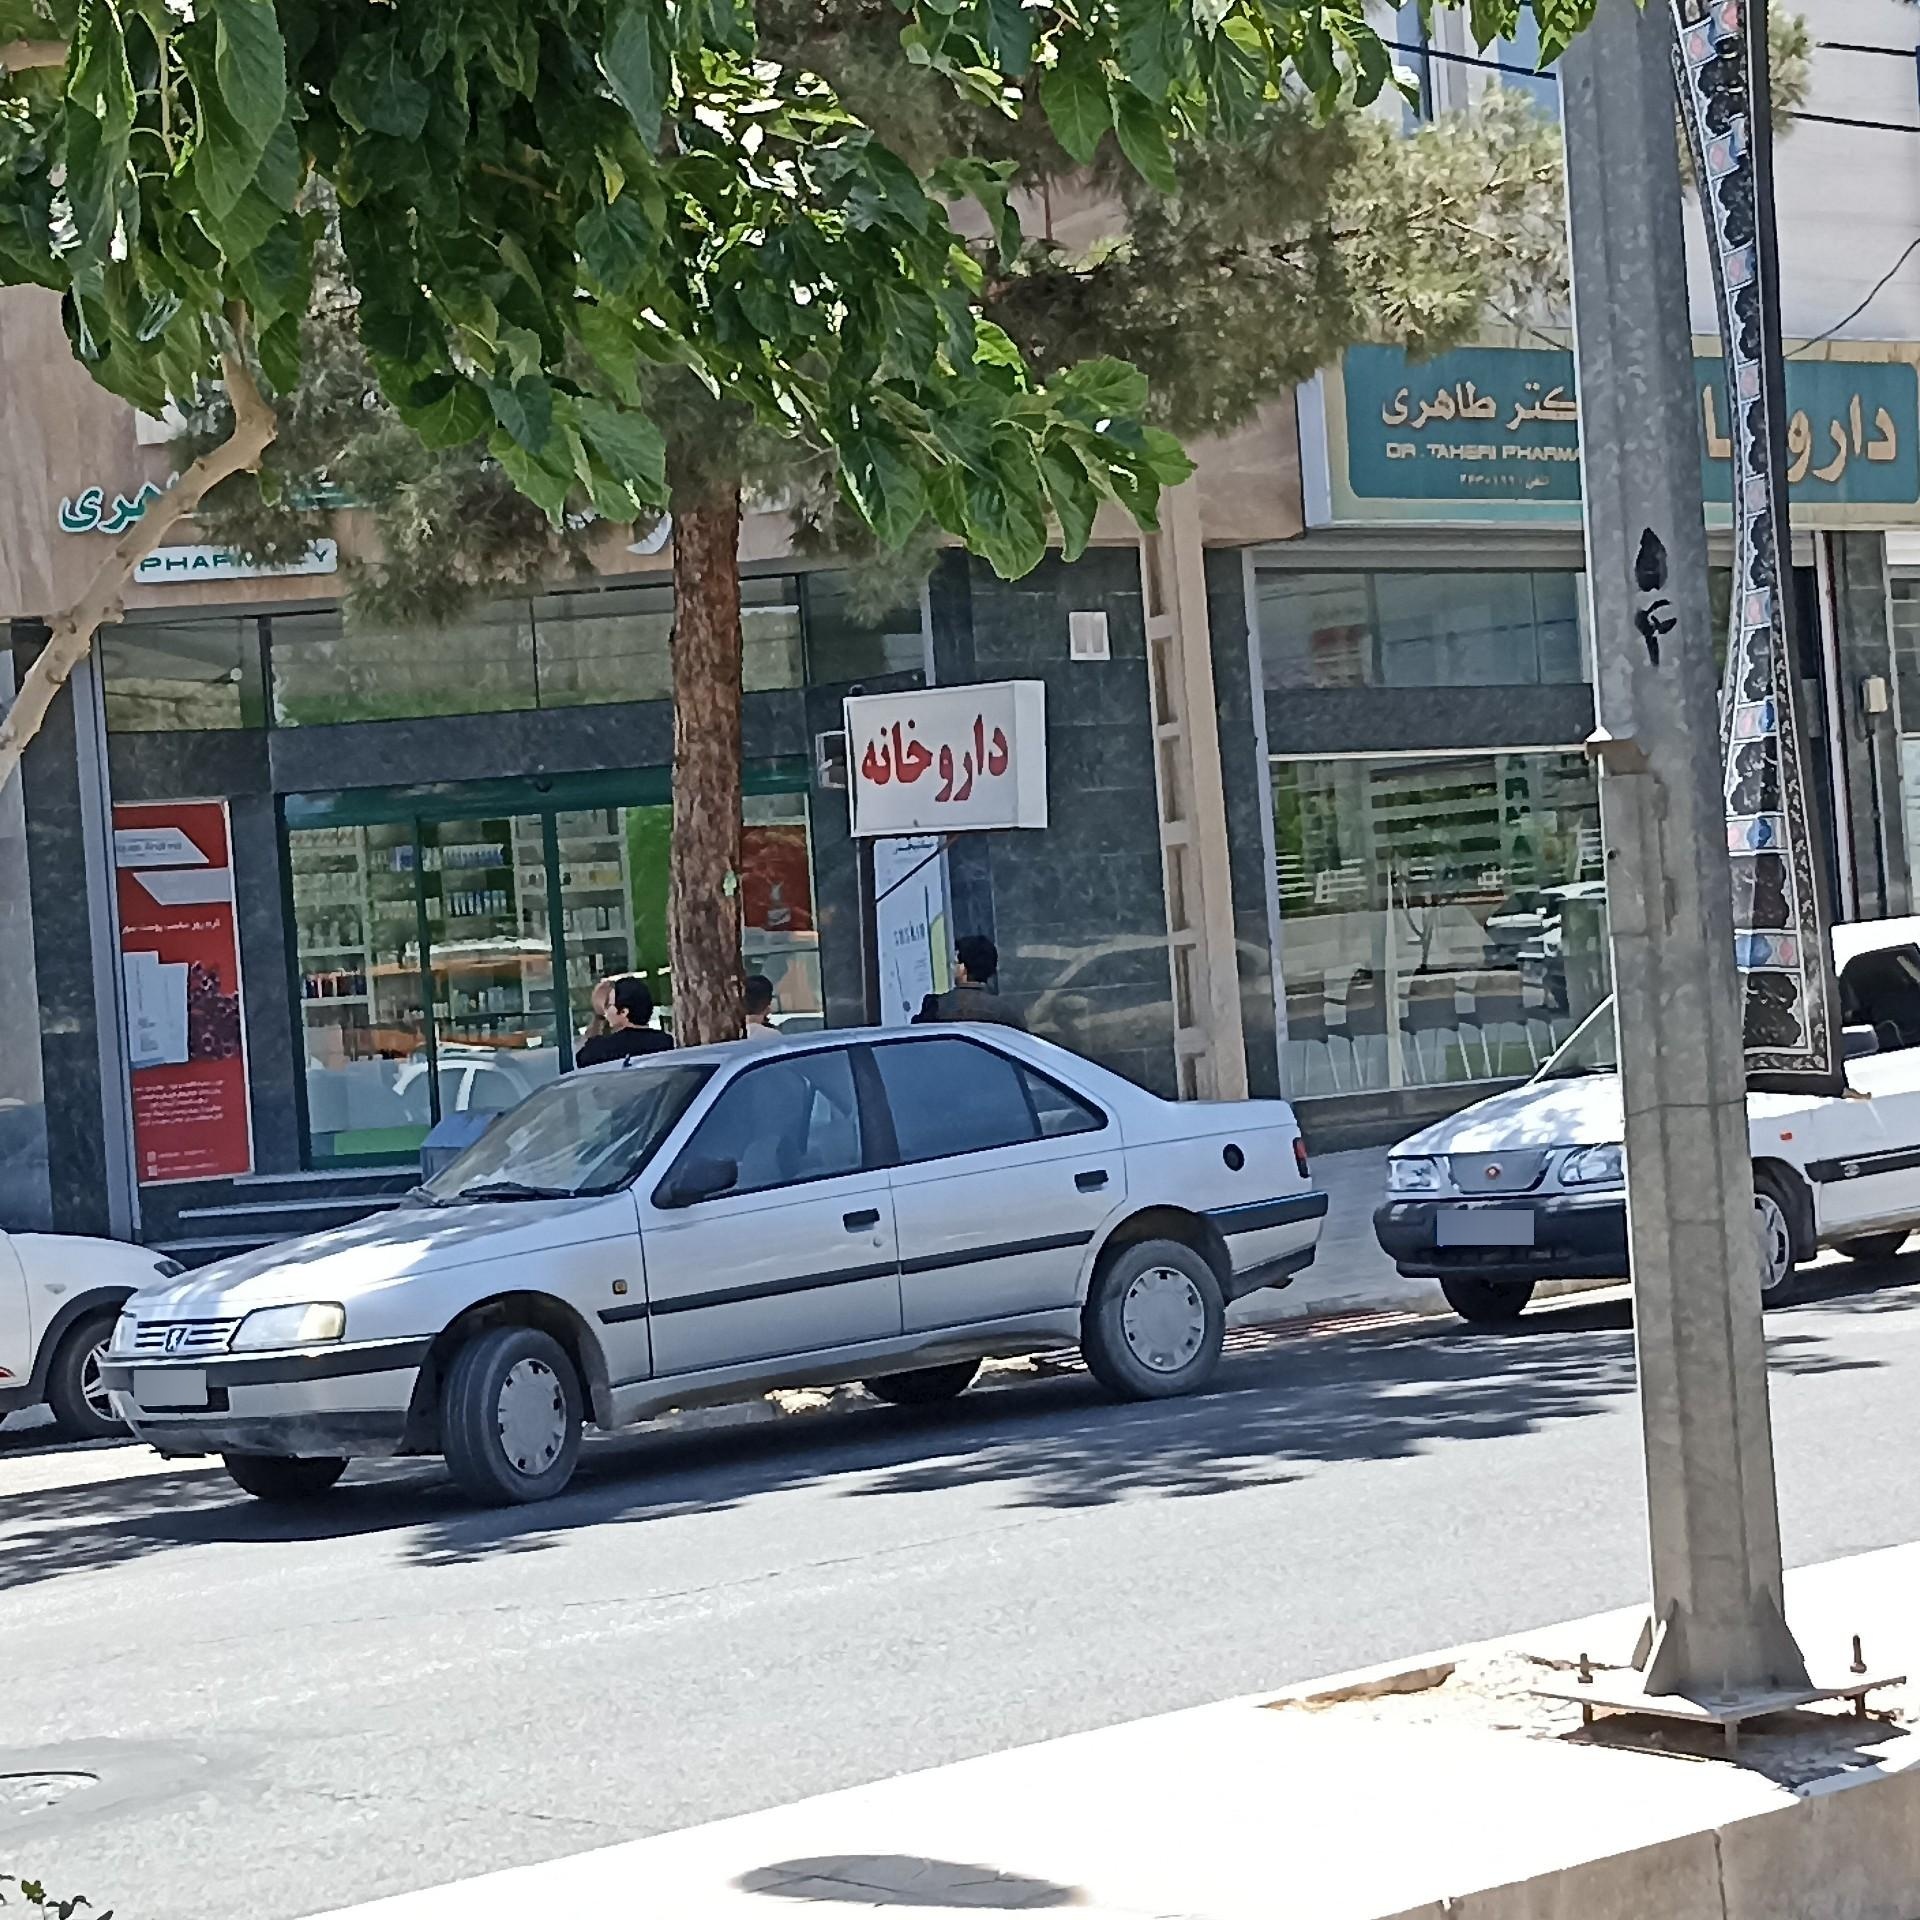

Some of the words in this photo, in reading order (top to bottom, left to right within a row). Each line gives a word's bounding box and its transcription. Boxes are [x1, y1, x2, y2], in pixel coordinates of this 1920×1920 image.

[1382, 381, 1497, 430] طاهری
[1505, 381, 1580, 431] کتر
[1427, 443, 1497, 461] TAHERI
[1502, 445, 1580, 463] PHARMA
[861, 713, 1009, 803] داروخانه
